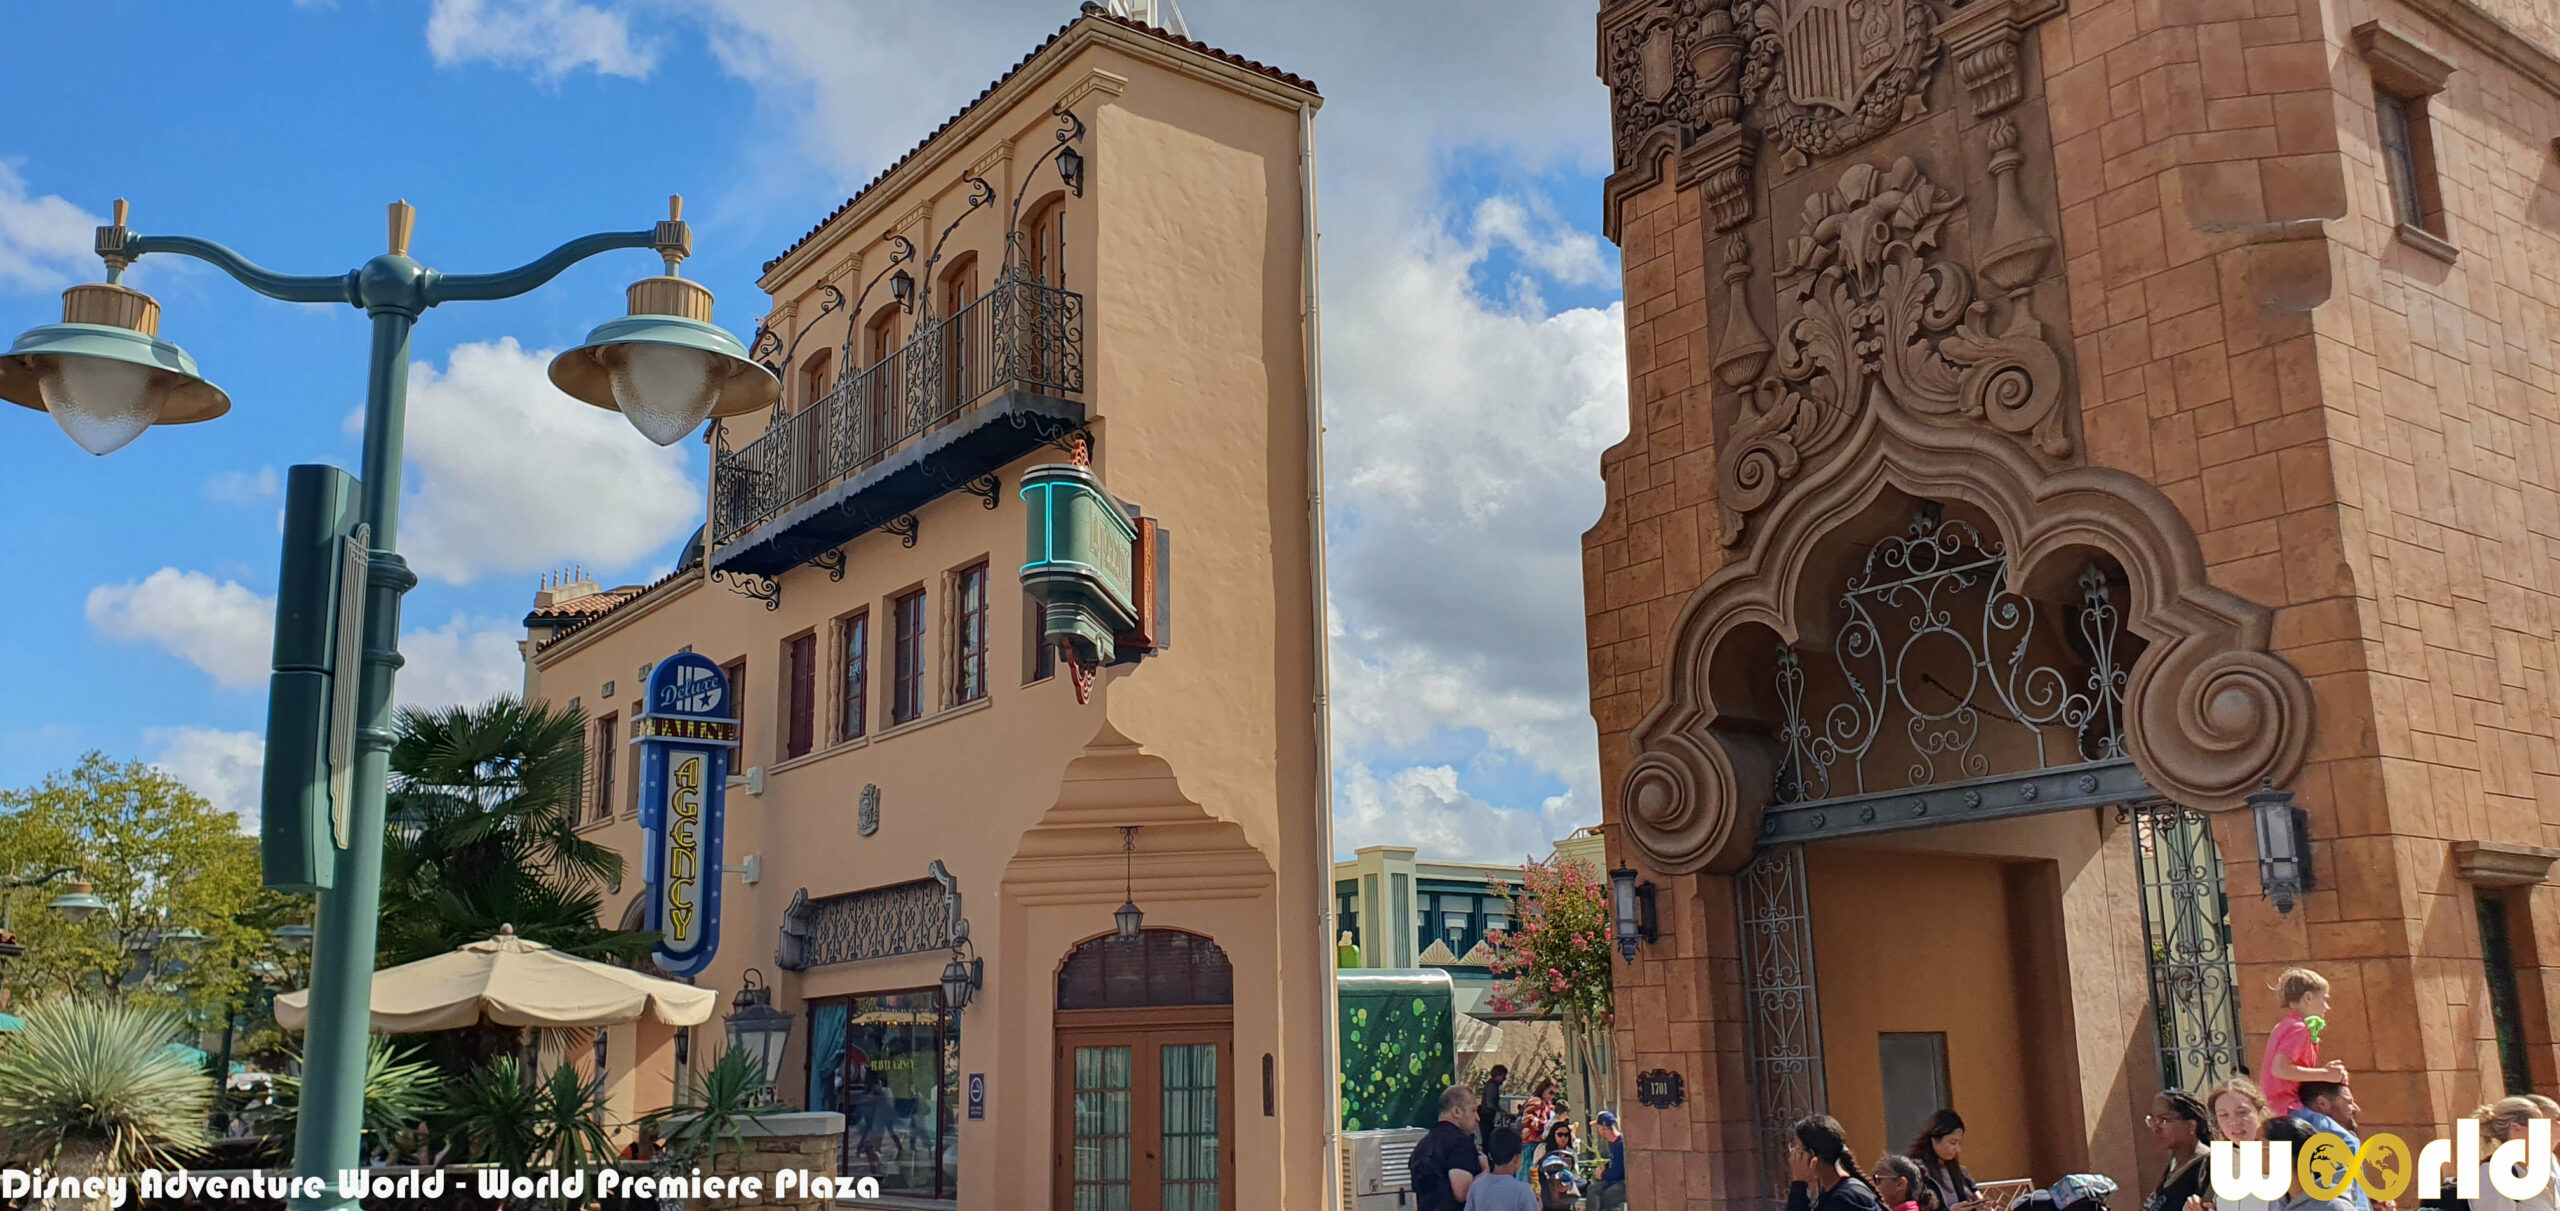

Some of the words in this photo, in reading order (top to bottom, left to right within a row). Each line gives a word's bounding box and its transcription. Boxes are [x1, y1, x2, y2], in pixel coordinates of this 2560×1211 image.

[660, 677, 719, 707] Deluxe
[649, 717, 737, 742] TALENT
[669, 757, 700, 941] AGENCY
[1650, 1082, 1668, 1096] 1701
